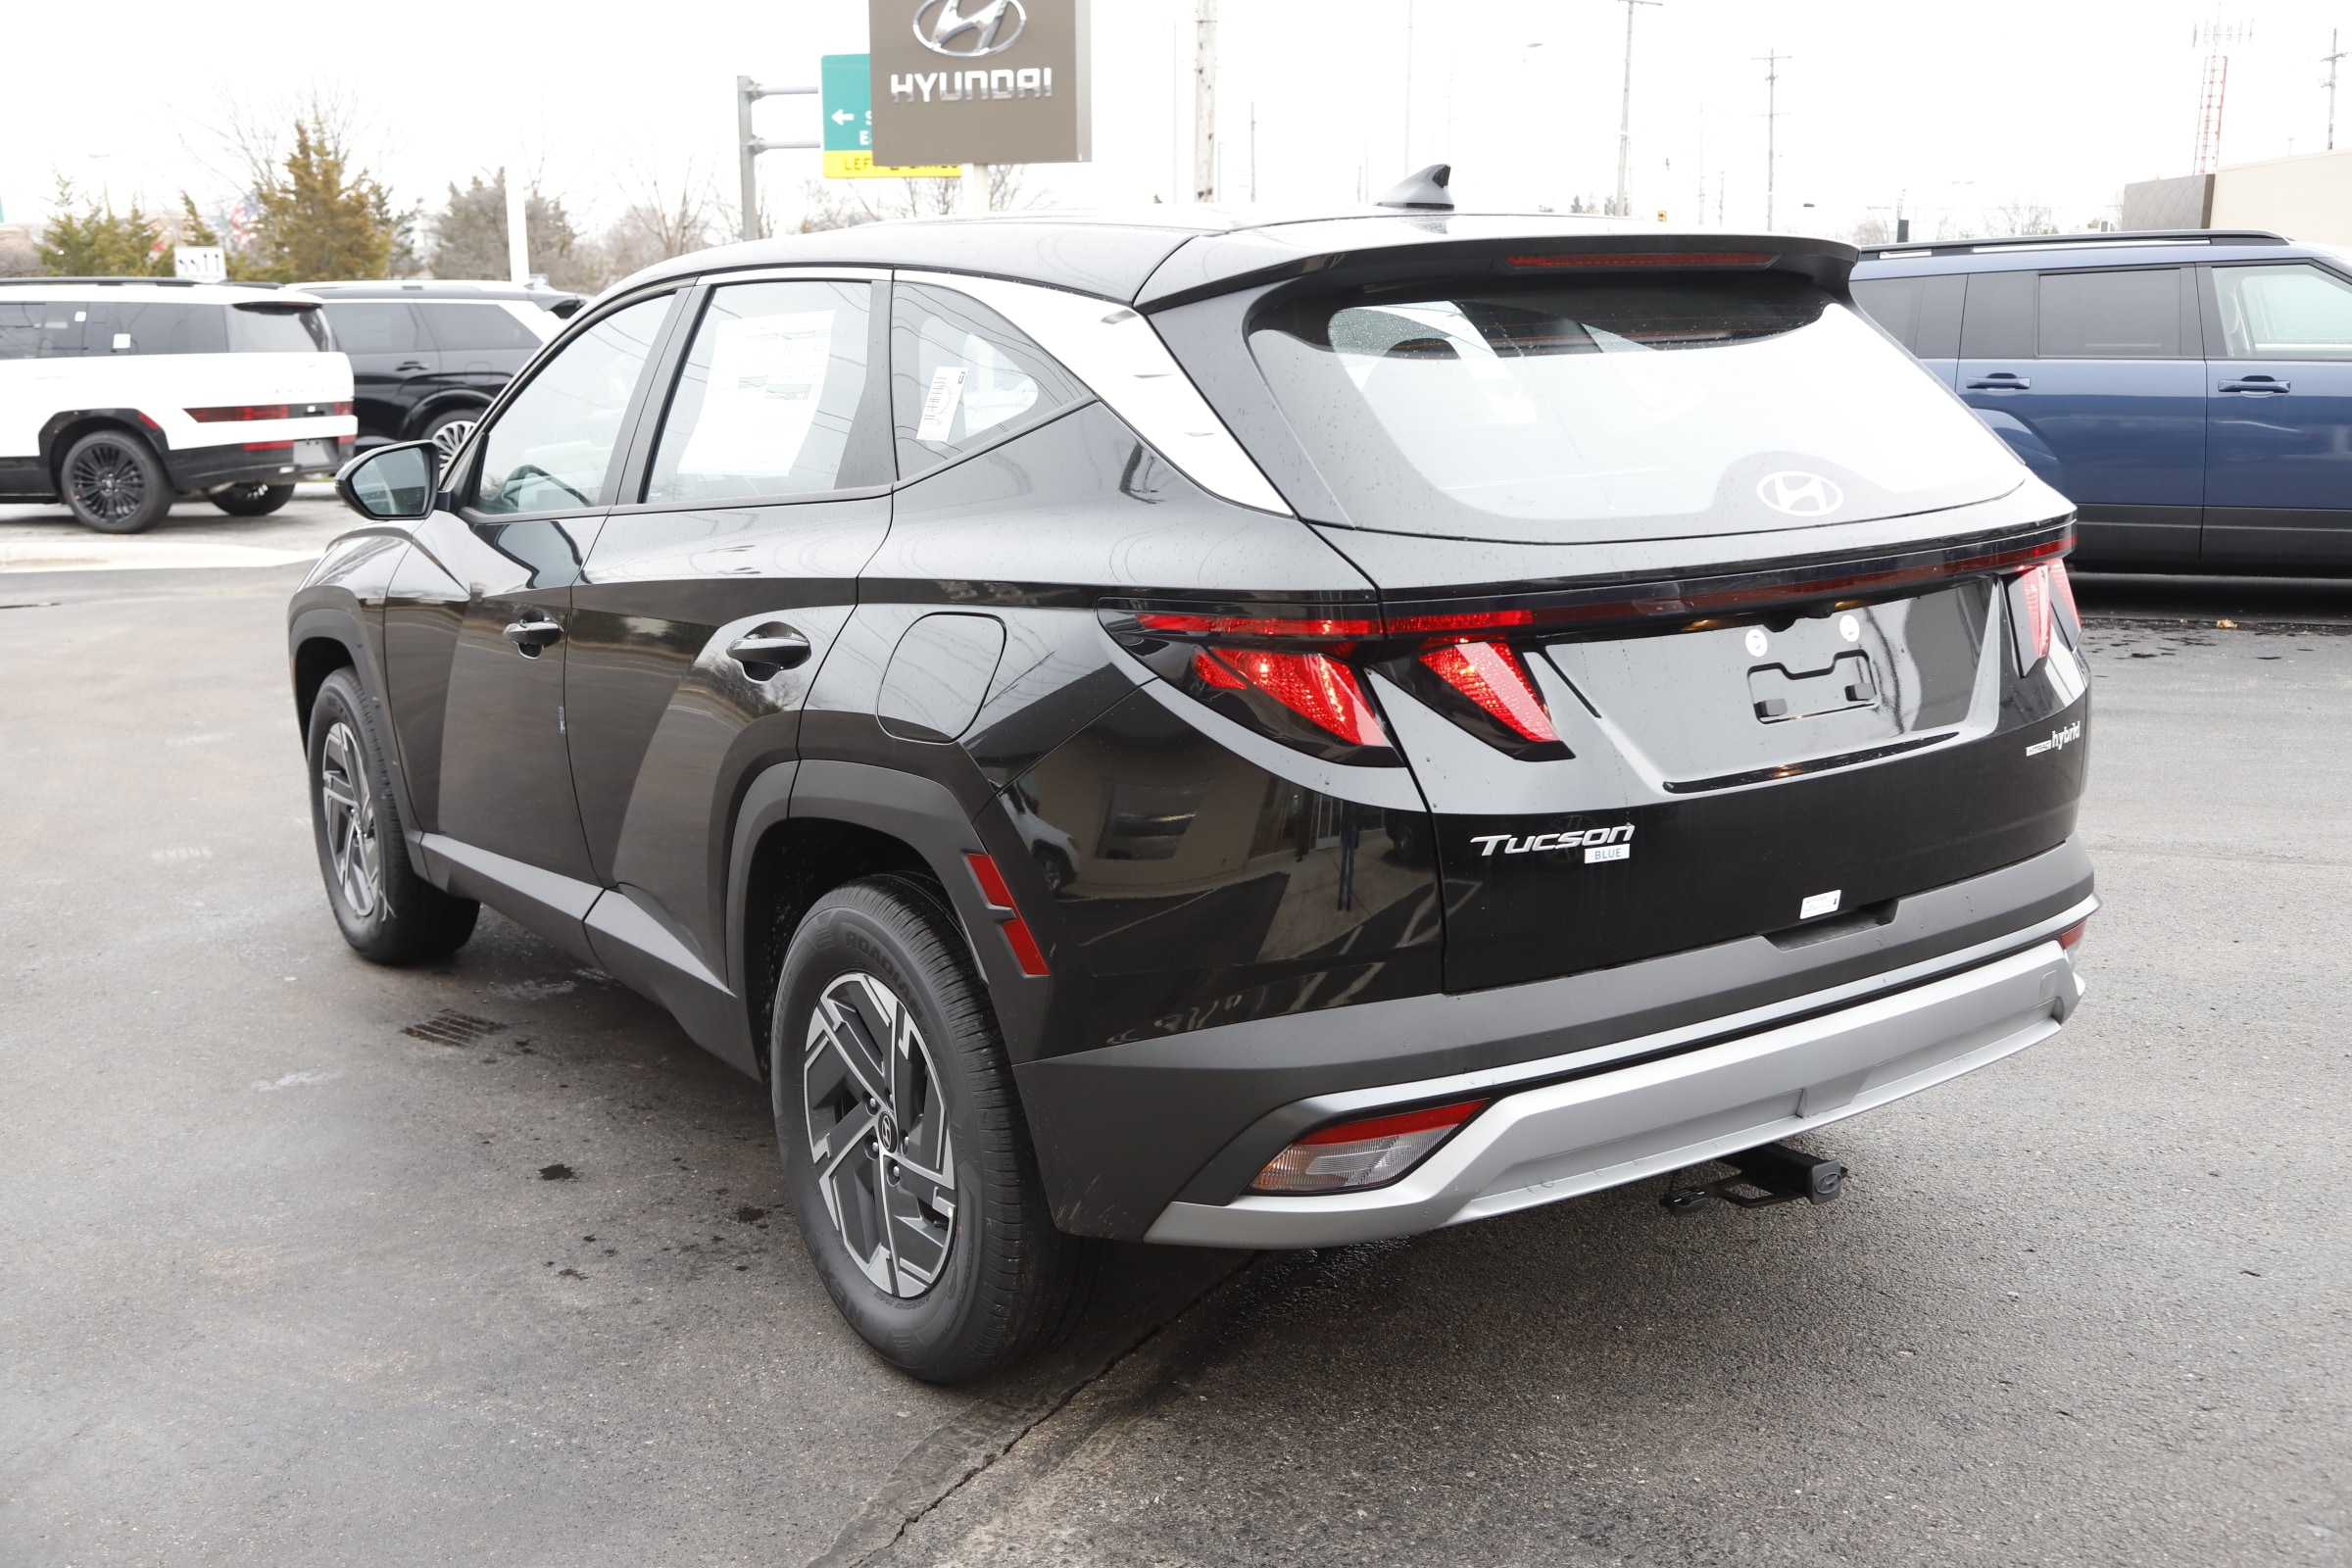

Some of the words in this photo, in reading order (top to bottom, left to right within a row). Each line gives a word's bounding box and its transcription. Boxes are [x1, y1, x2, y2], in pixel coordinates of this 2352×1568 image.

[890, 68, 1053, 102] HYUNDAI
[2051, 720, 2081, 751] hybrid
[1594, 848, 1622, 860] BLUE
